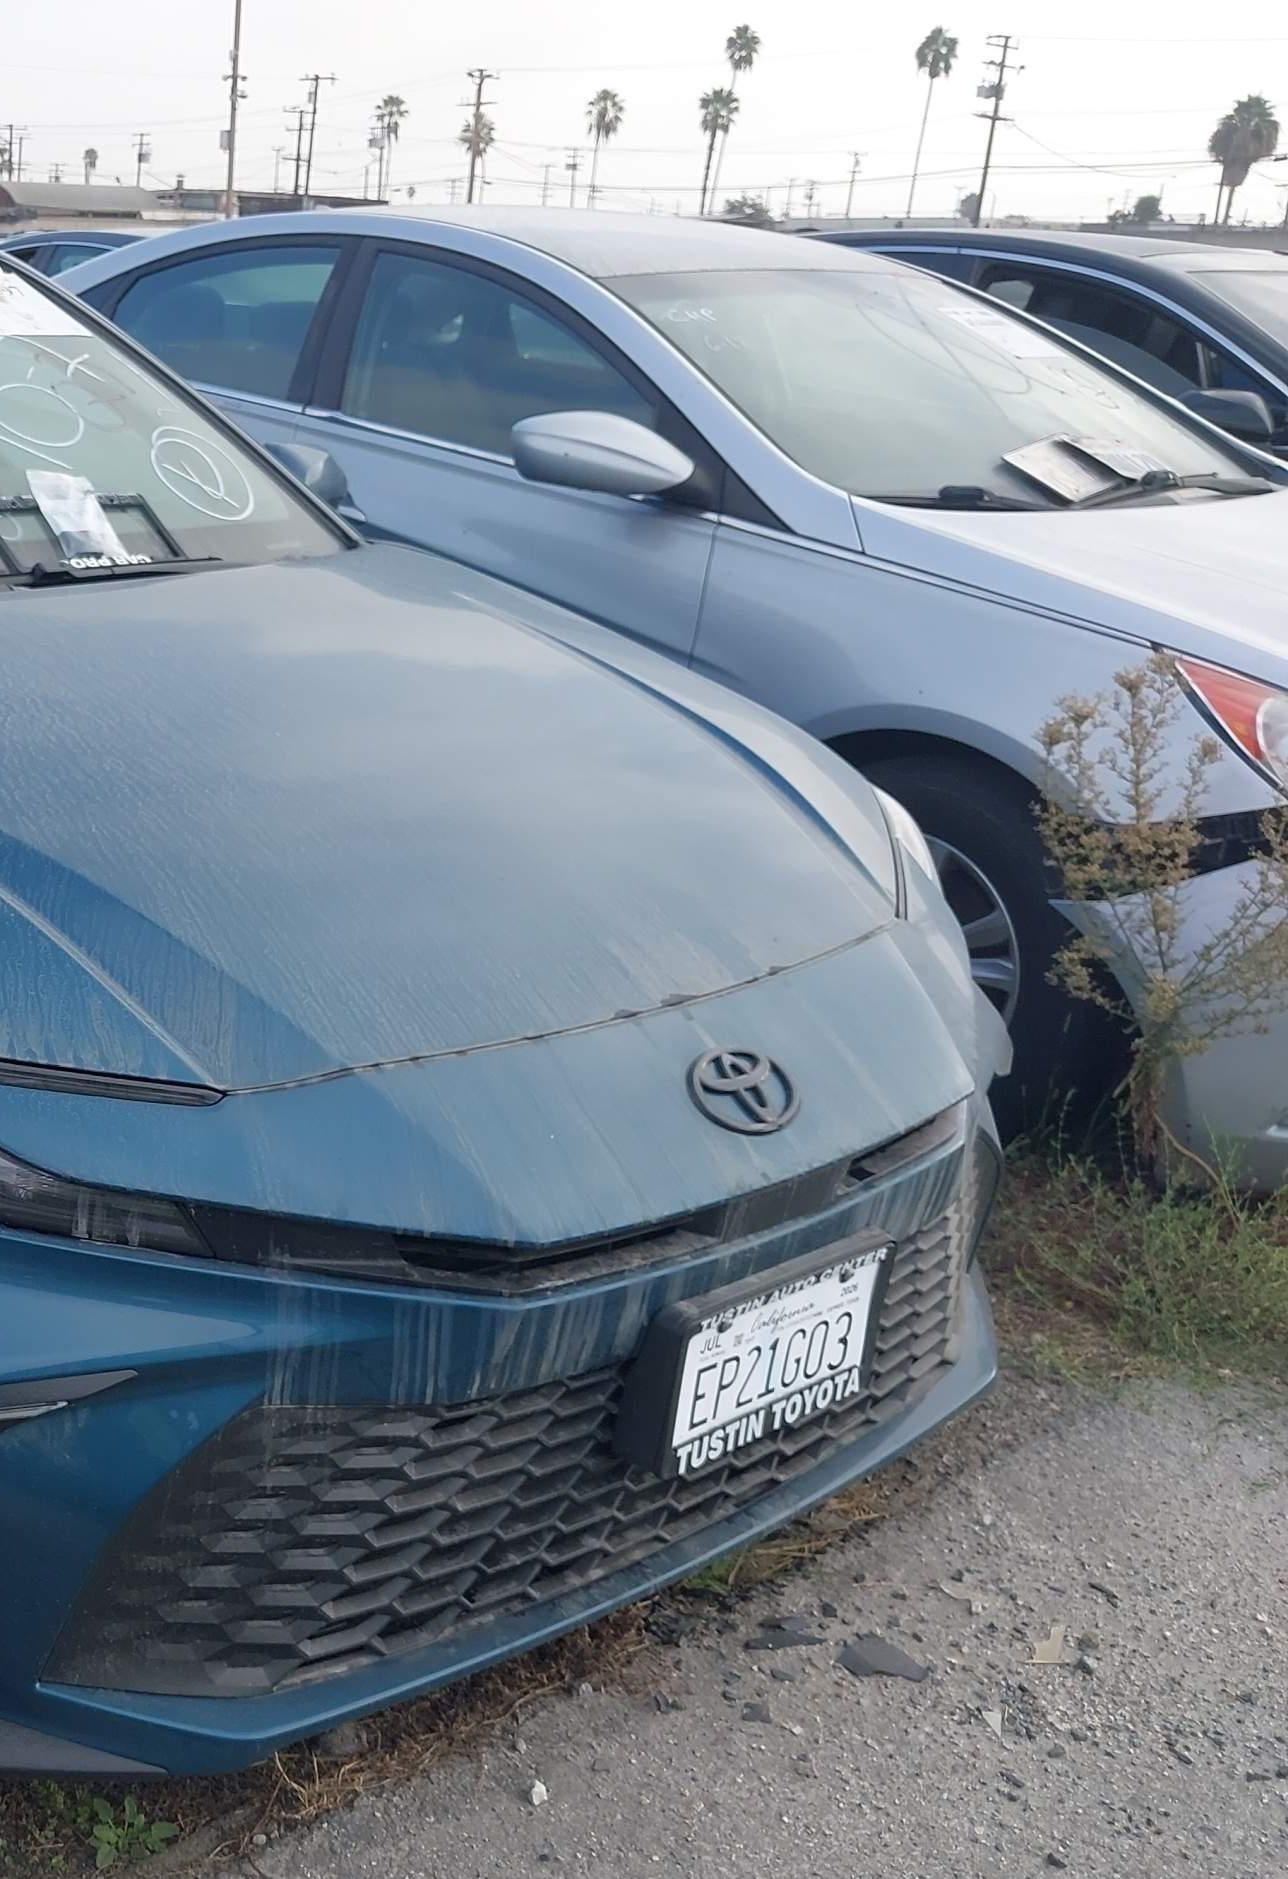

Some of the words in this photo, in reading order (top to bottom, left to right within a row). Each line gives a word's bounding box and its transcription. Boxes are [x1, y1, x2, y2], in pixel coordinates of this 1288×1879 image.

[699, 1333, 723, 1354] JUL
[749, 1301, 816, 1334] California
[687, 1310, 853, 1432] EP21G03
[675, 1408, 765, 1476] TUSTIN
[771, 1366, 861, 1431] TOYOTA
